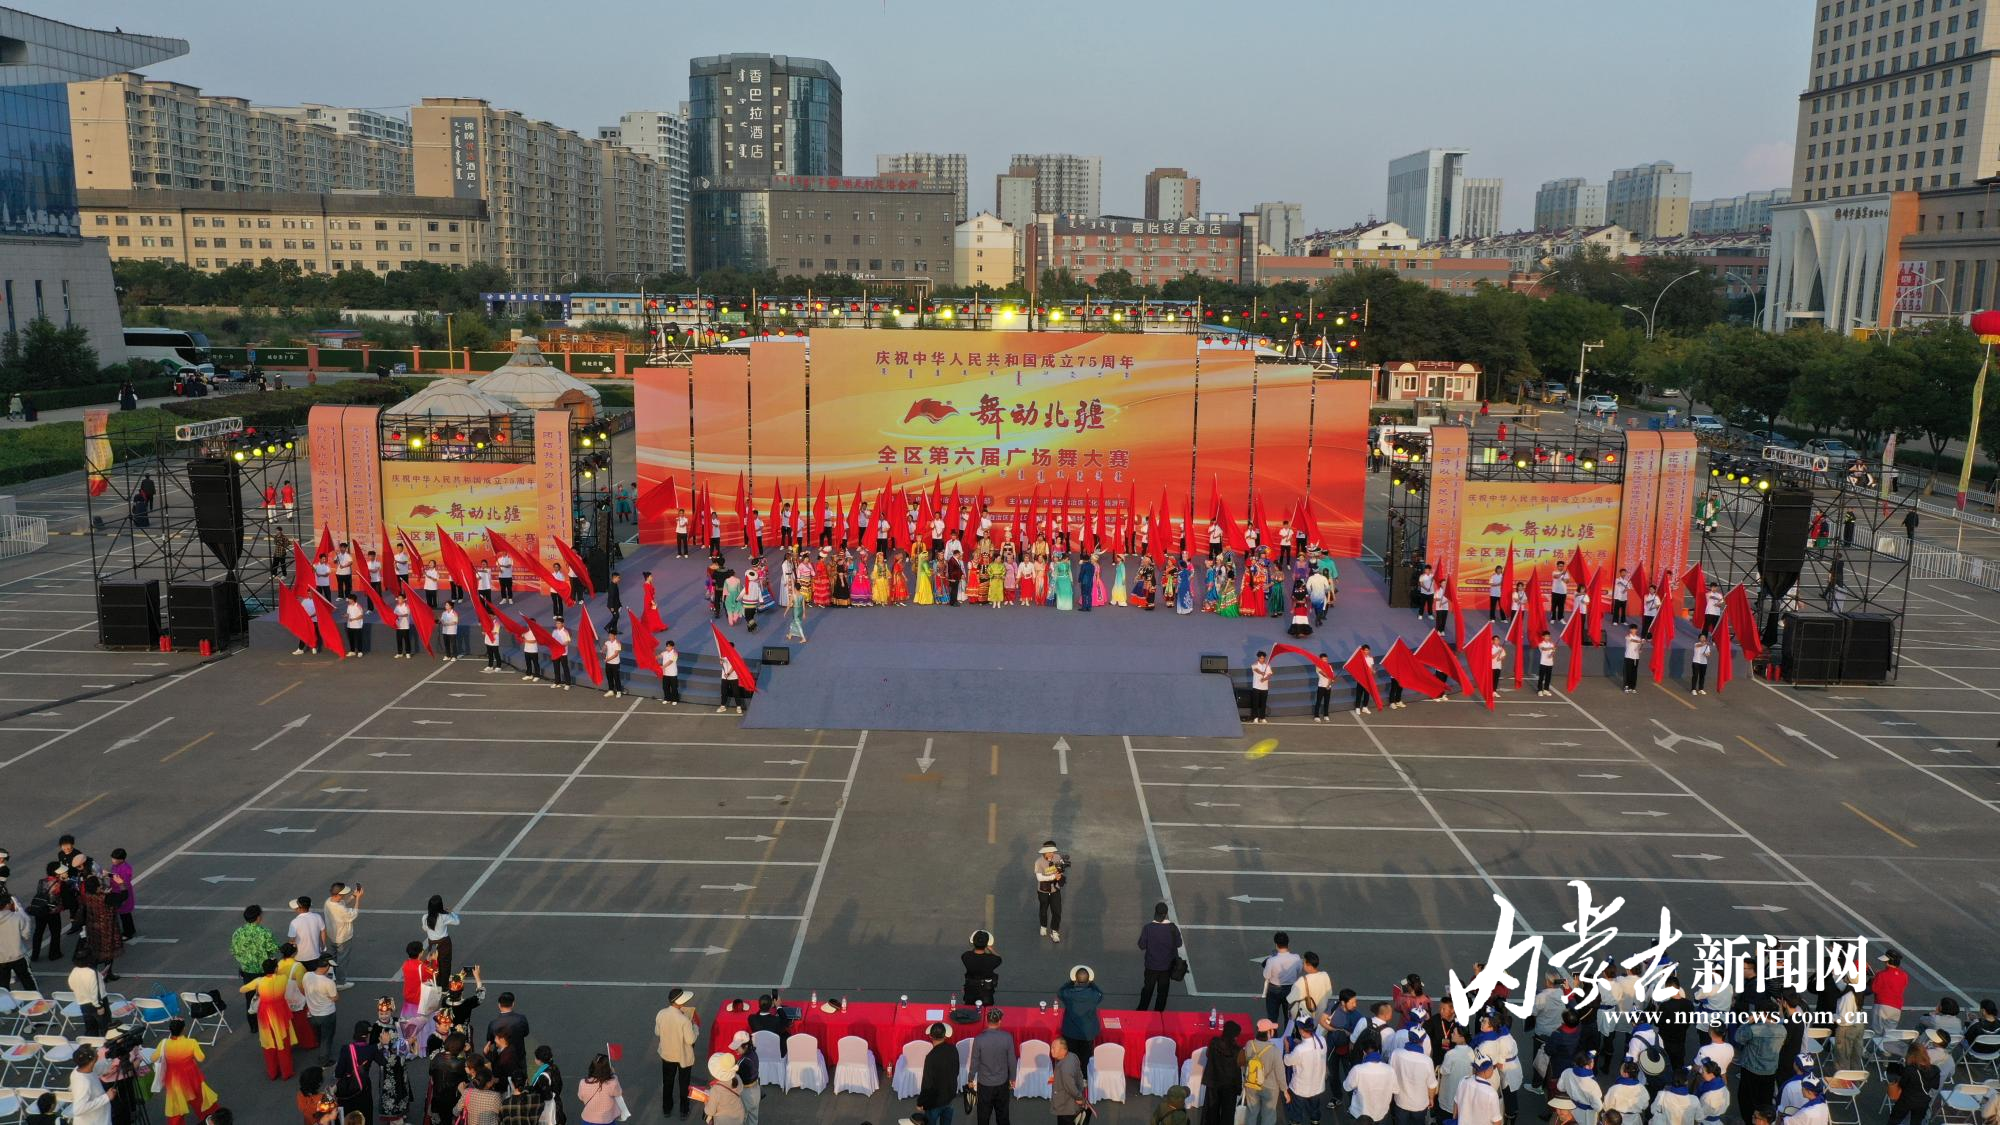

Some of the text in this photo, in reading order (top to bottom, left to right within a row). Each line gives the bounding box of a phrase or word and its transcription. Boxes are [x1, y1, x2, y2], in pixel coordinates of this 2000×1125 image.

[749, 69, 763, 159] 香巴拉酒店
[875, 351, 1134, 369] 庆祝中华人民共和国成立75周年
[970, 393, 1105, 440] 舞动北疆
[877, 445, 1130, 468] 全区第六届广场舞大赛
[391, 474, 536, 485] 庆祝中华人民共和国成立75周年
[1468, 494, 1614, 504] 庆祝中华人民共和国成立75周年
[446, 502, 522, 526] 舞动北疆
[1520, 520, 1596, 544] 舞动北疆
